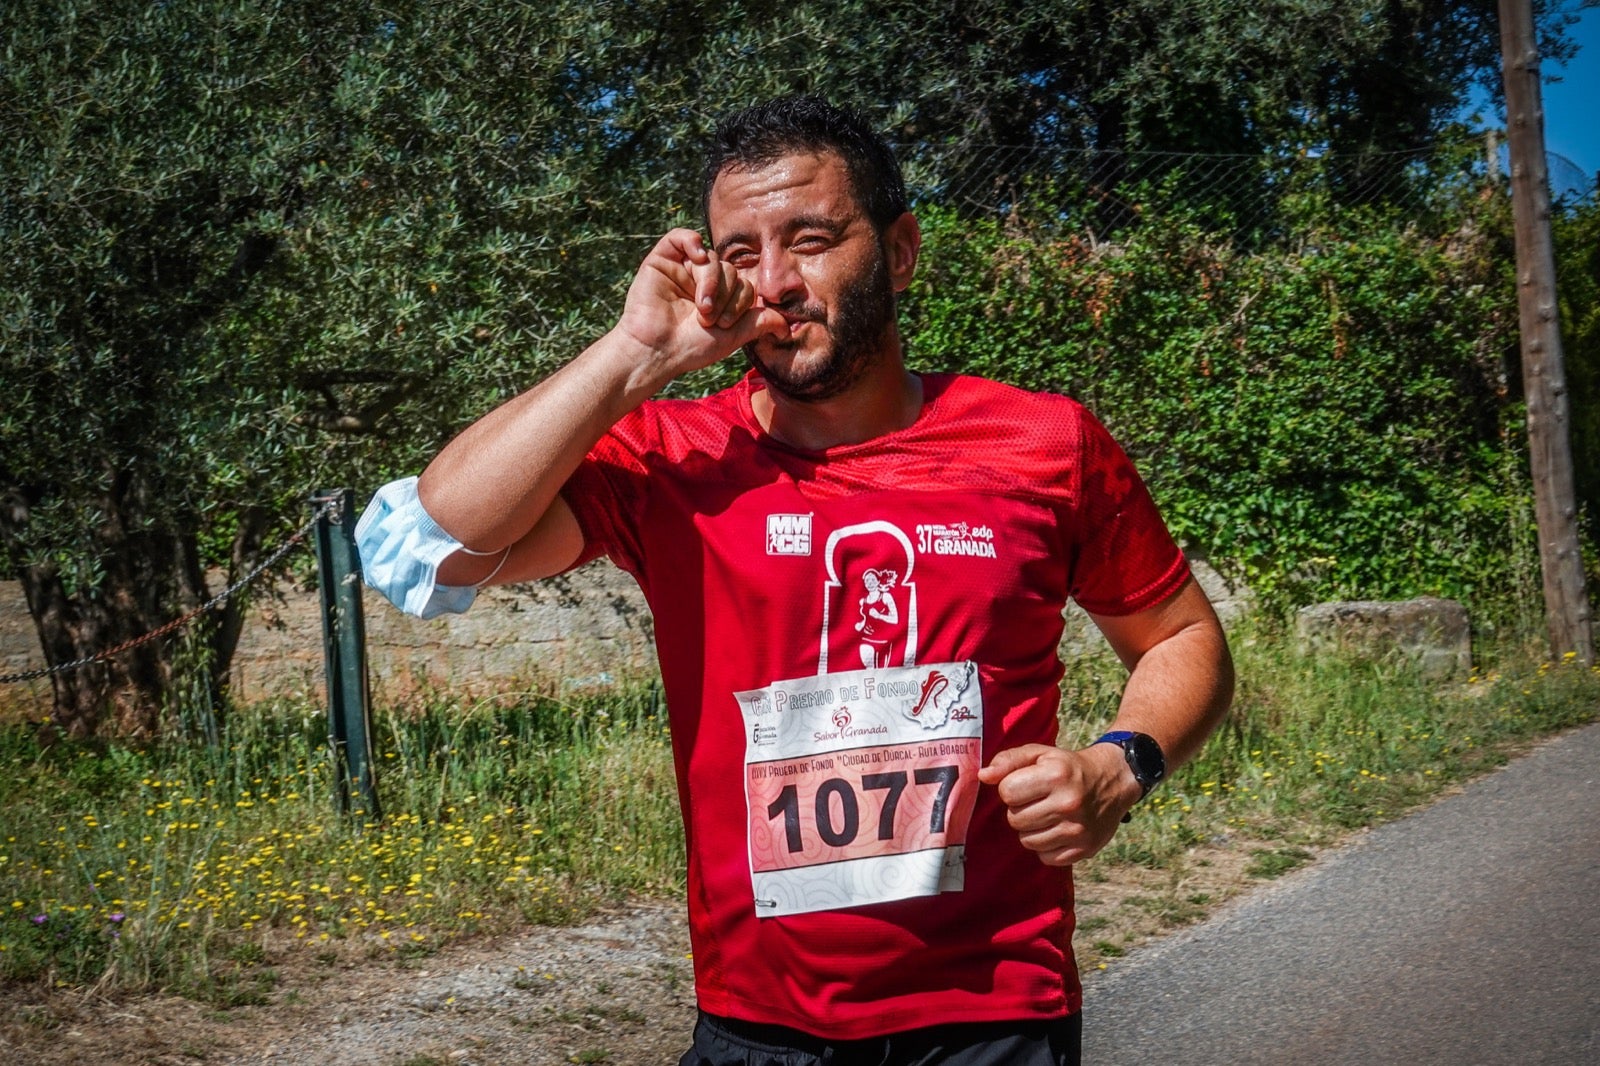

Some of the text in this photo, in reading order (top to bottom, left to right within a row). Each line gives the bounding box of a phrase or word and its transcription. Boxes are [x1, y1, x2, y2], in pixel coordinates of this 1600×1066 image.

[916, 524, 932, 554] 37
[972, 525, 994, 541] edp
[934, 539, 997, 559] GRANADA
[814, 724, 888, 742] Sabor Granada
[767, 765, 960, 853] 1077
